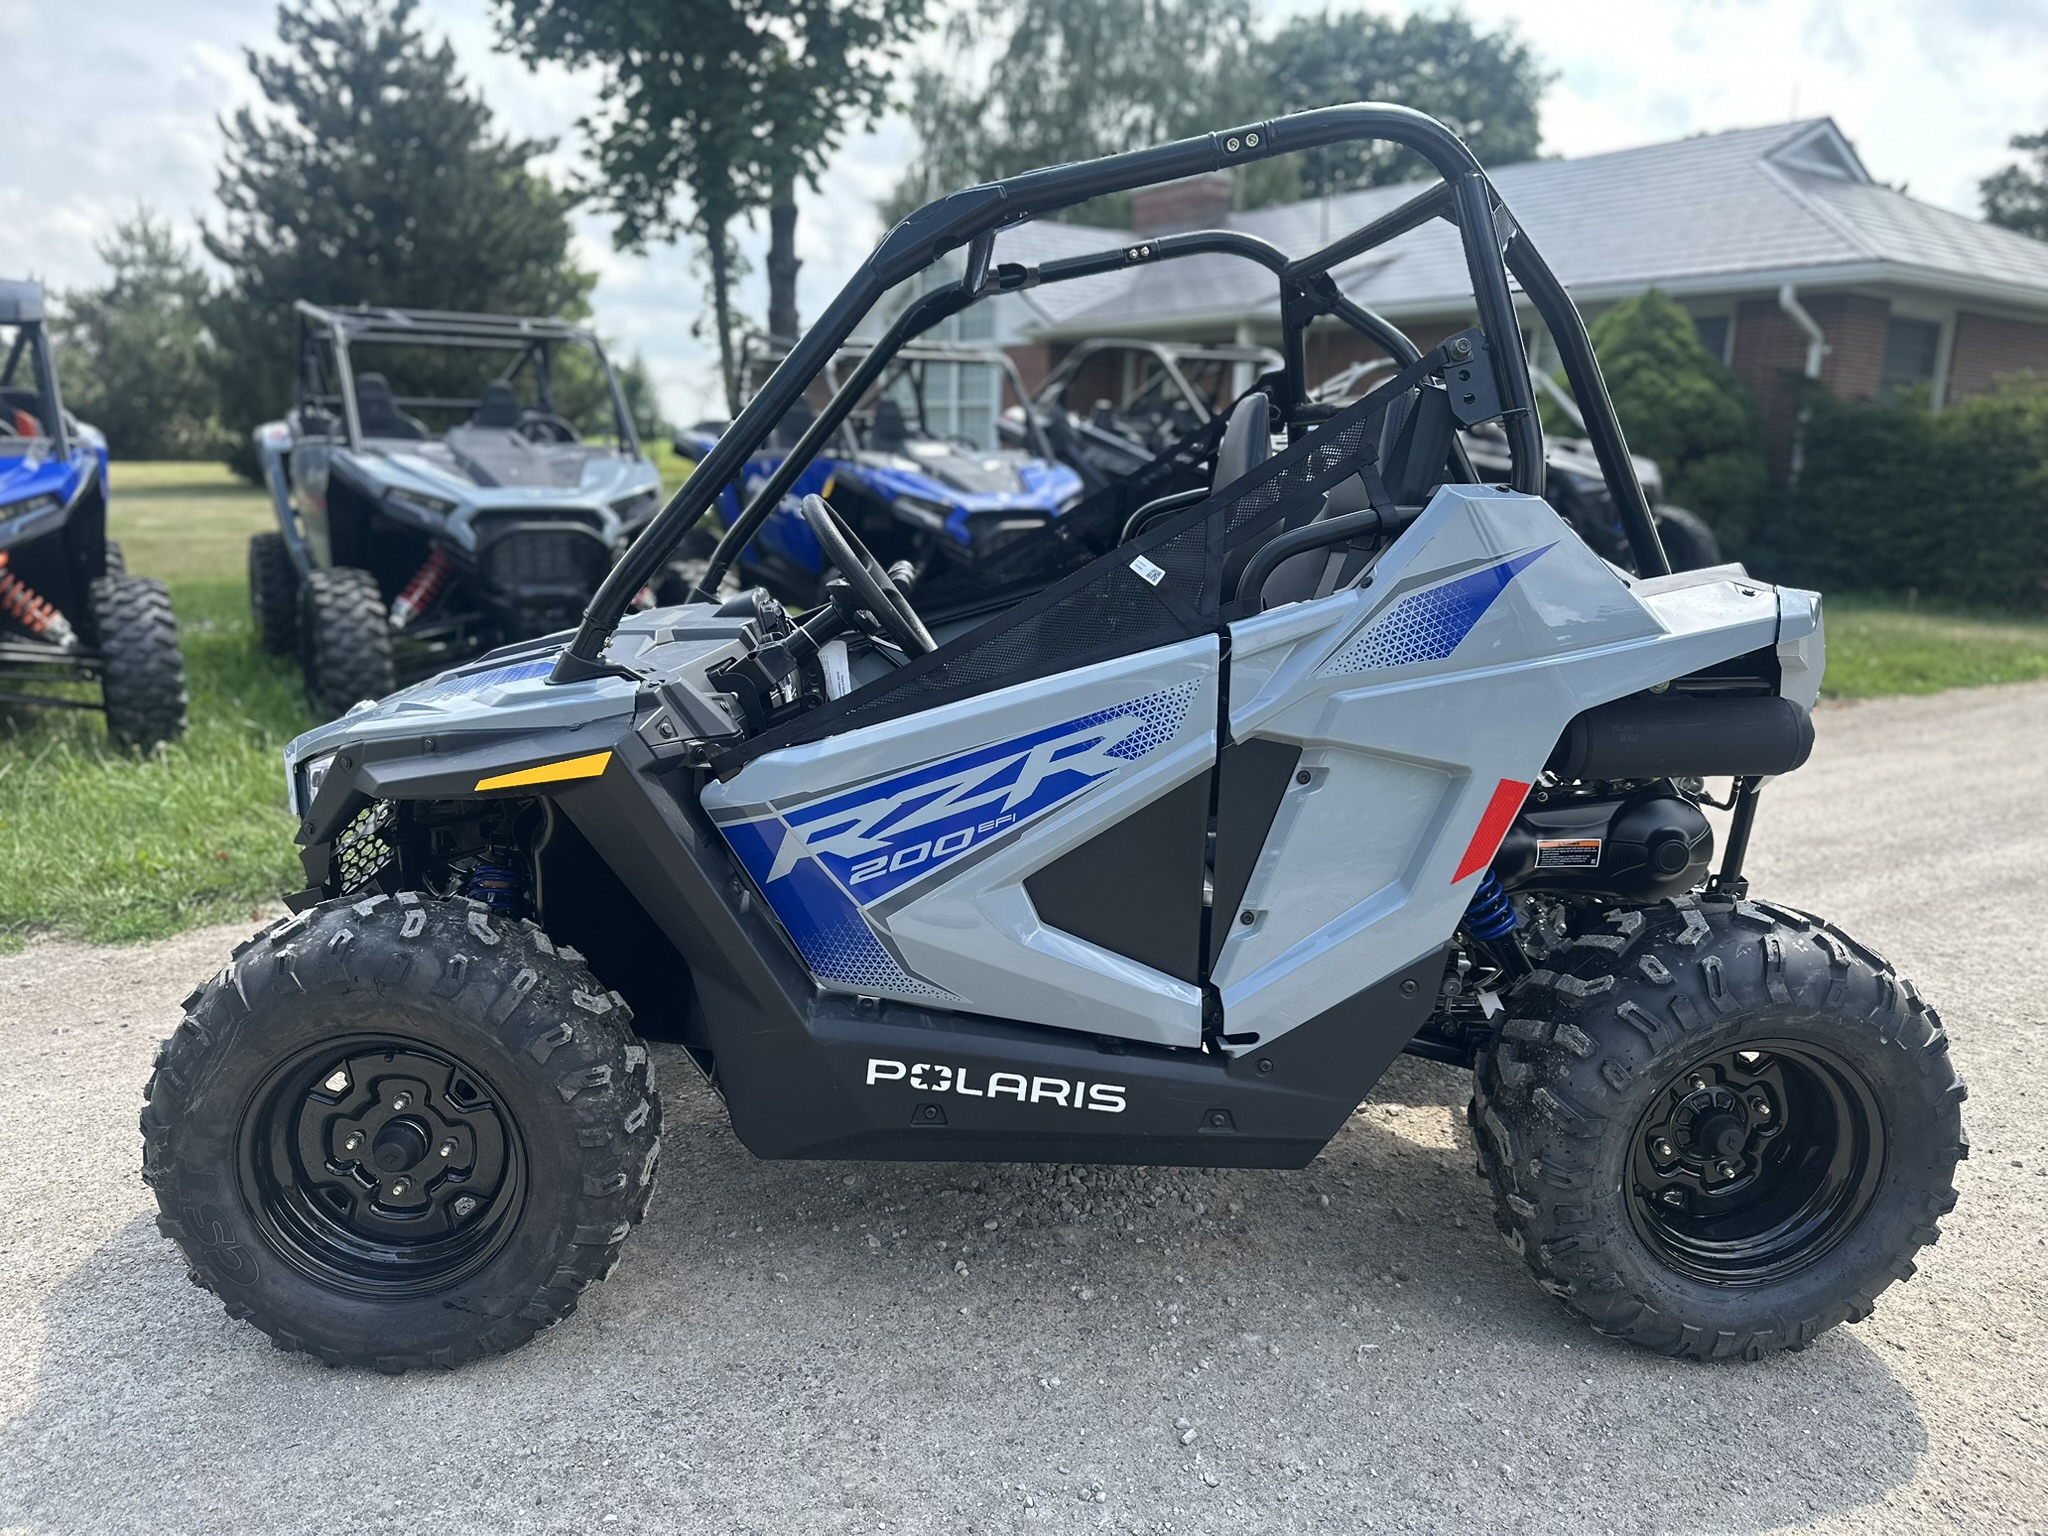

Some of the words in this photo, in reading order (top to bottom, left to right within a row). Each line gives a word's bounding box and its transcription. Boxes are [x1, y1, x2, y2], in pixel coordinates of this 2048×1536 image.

[766, 714, 1150, 884] RZR
[849, 826, 975, 886] 200
[976, 812, 1017, 834] EFI
[866, 1058, 1127, 1113] POLARIS
[174, 1154, 261, 1287] CST
